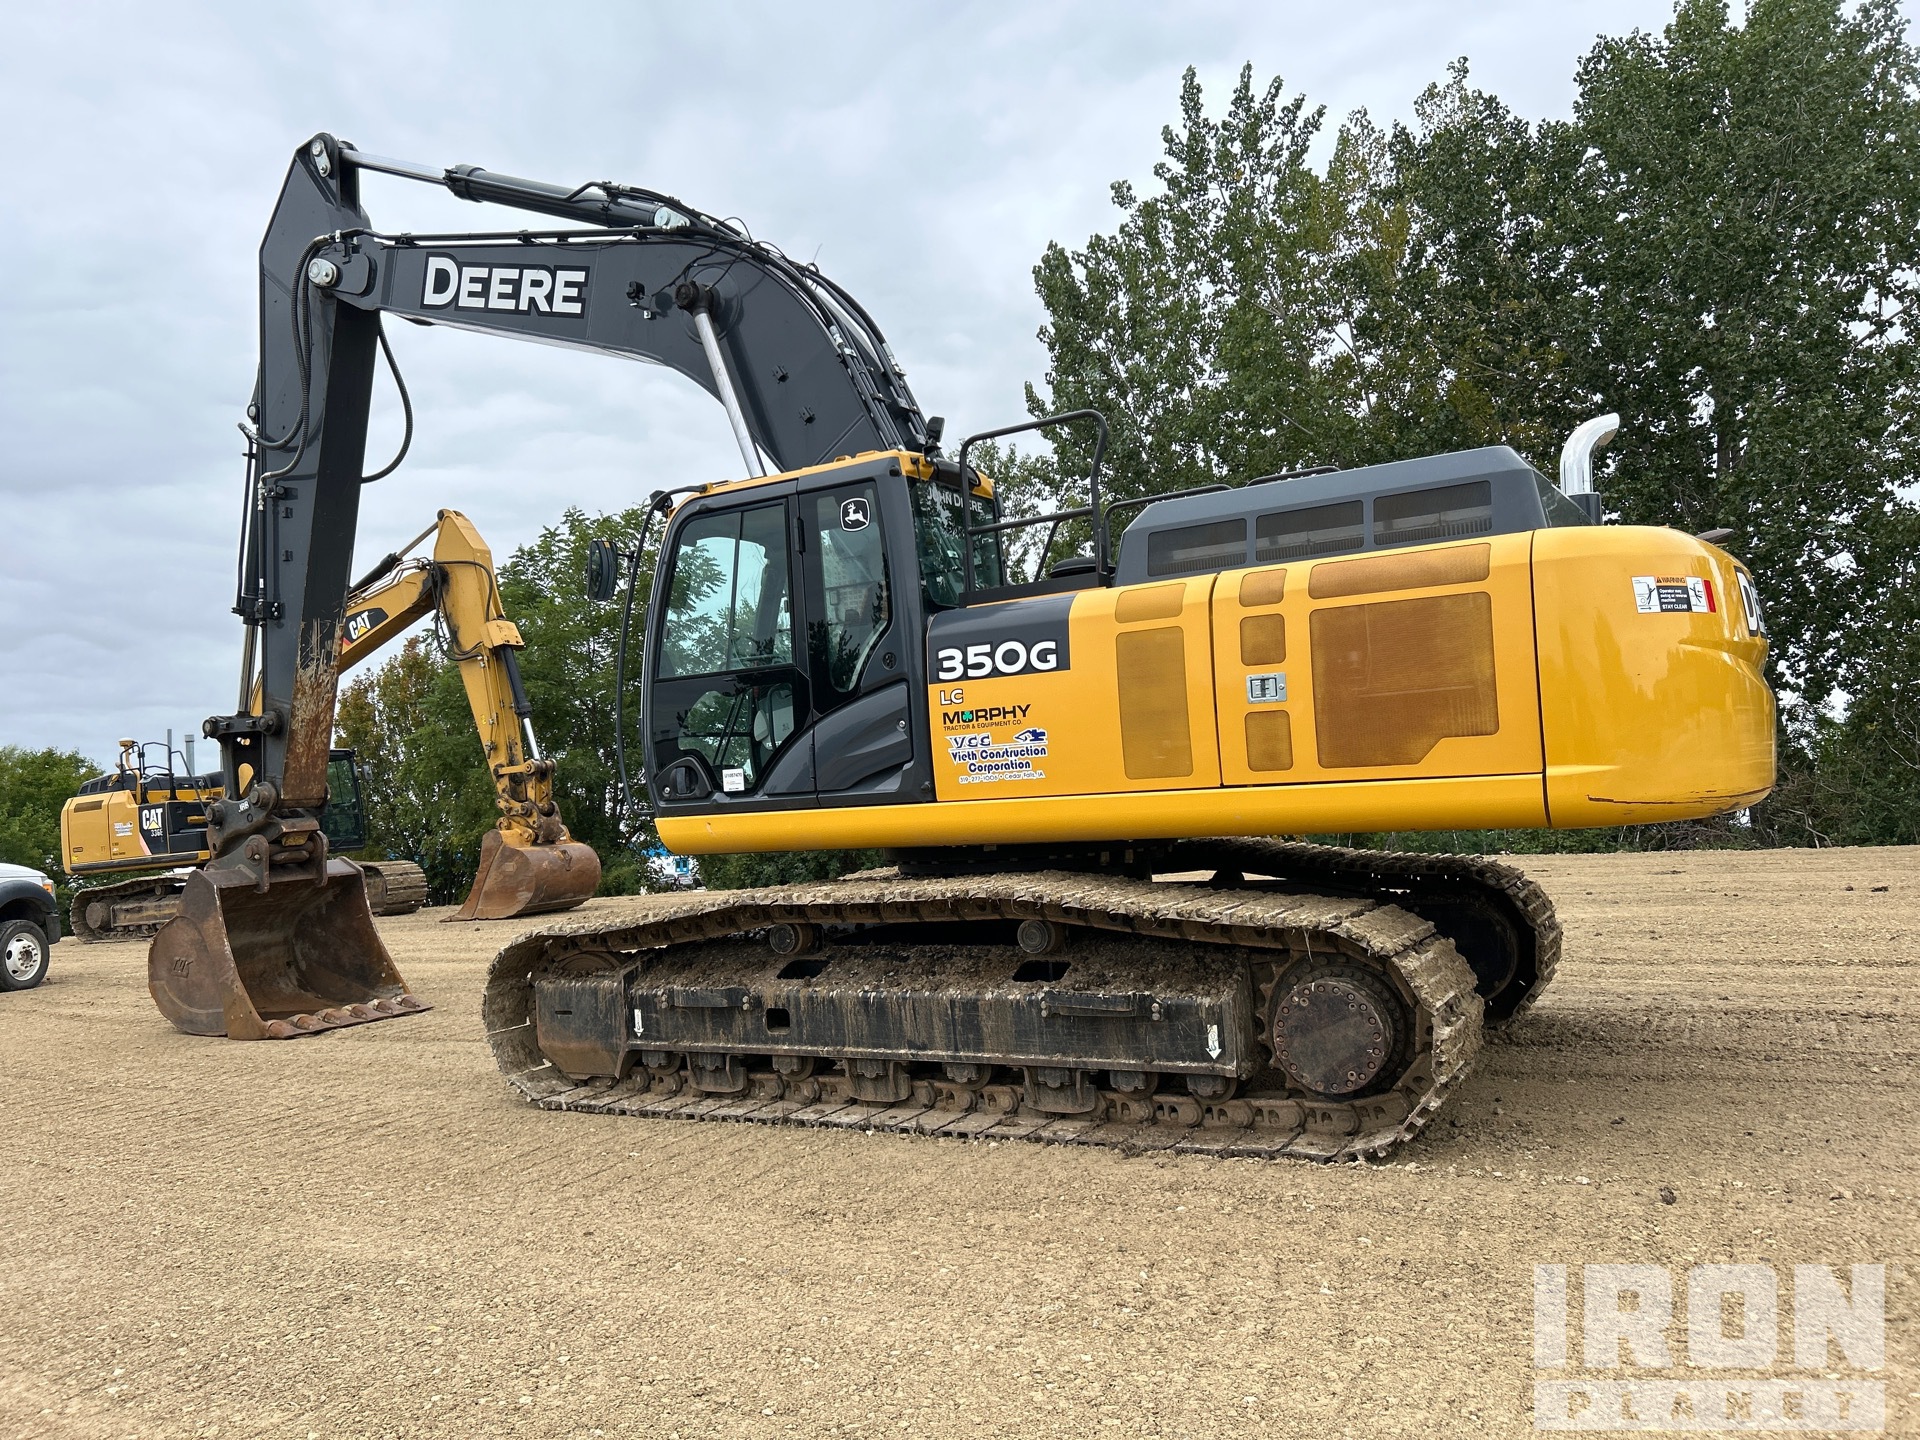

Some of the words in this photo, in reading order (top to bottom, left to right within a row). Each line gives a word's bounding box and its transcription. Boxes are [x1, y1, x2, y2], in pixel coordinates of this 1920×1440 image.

[423, 256, 586, 314] DEERE
[954, 493, 984, 513] DRE
[349, 611, 371, 640] CAT
[937, 641, 1057, 680] 350G
[940, 688, 964, 706] LC
[943, 704, 1031, 725] MURPHY
[944, 724, 971, 732] TRACTOR
[977, 720, 1011, 729] EQUIPMENT
[949, 734, 990, 749] VCC
[951, 750, 977, 762] Vieth
[980, 746, 1046, 760] Construction
[968, 760, 1031, 774] Corporation
[142, 808, 163, 830] CAT
